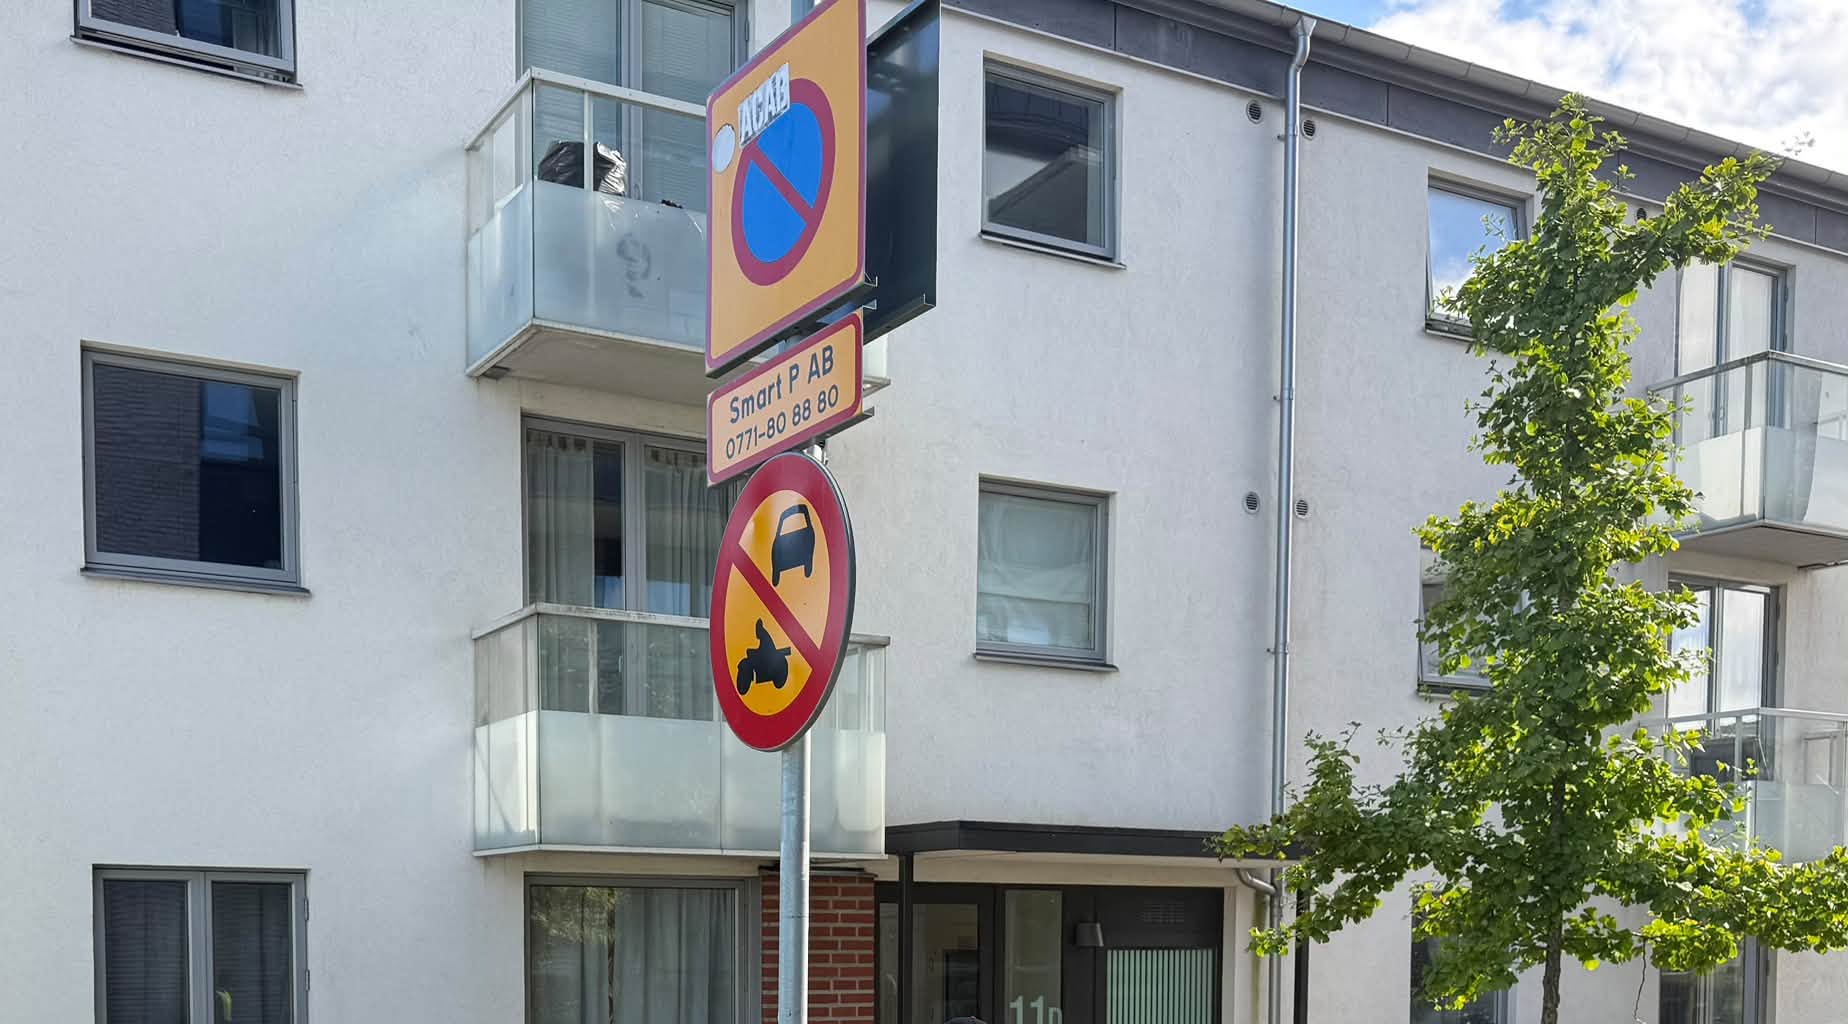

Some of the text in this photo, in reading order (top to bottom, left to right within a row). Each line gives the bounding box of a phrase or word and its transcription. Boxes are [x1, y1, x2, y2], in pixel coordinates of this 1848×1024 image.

[740, 70, 788, 143] ACAB
[726, 384, 839, 459] 0771-80 88 80
[730, 345, 834, 424] Smart P AB
